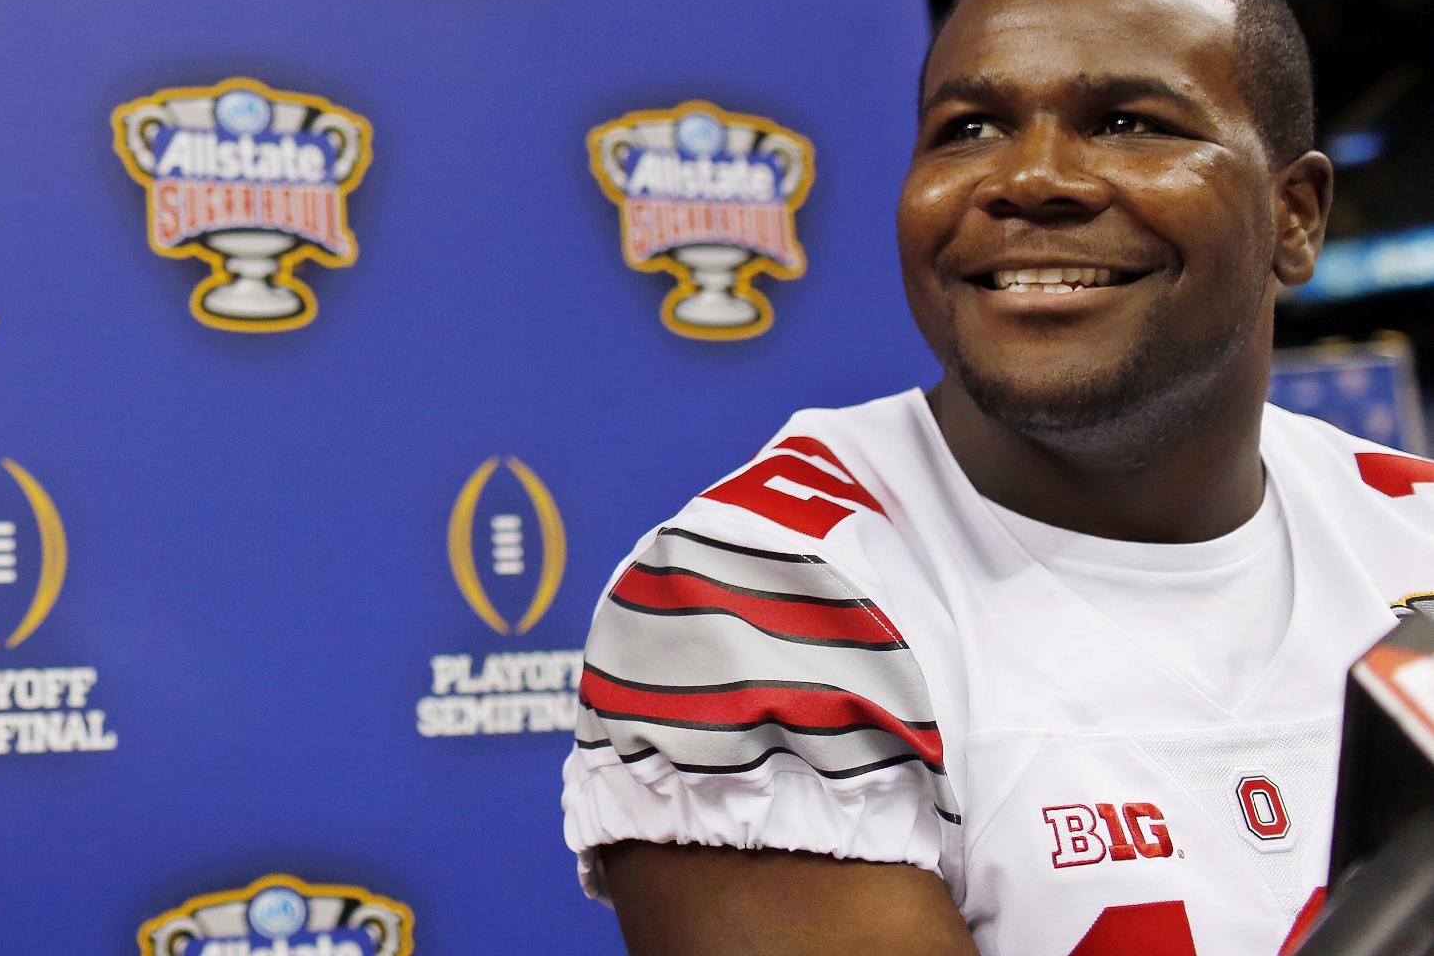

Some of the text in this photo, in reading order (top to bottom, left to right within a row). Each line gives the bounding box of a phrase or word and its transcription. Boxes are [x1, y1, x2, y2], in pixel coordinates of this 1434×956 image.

[156, 128, 326, 183] Allstate
[630, 151, 776, 202] Allstate
[417, 693, 579, 737] SEMIFIN
[1236, 774, 1292, 841] O
